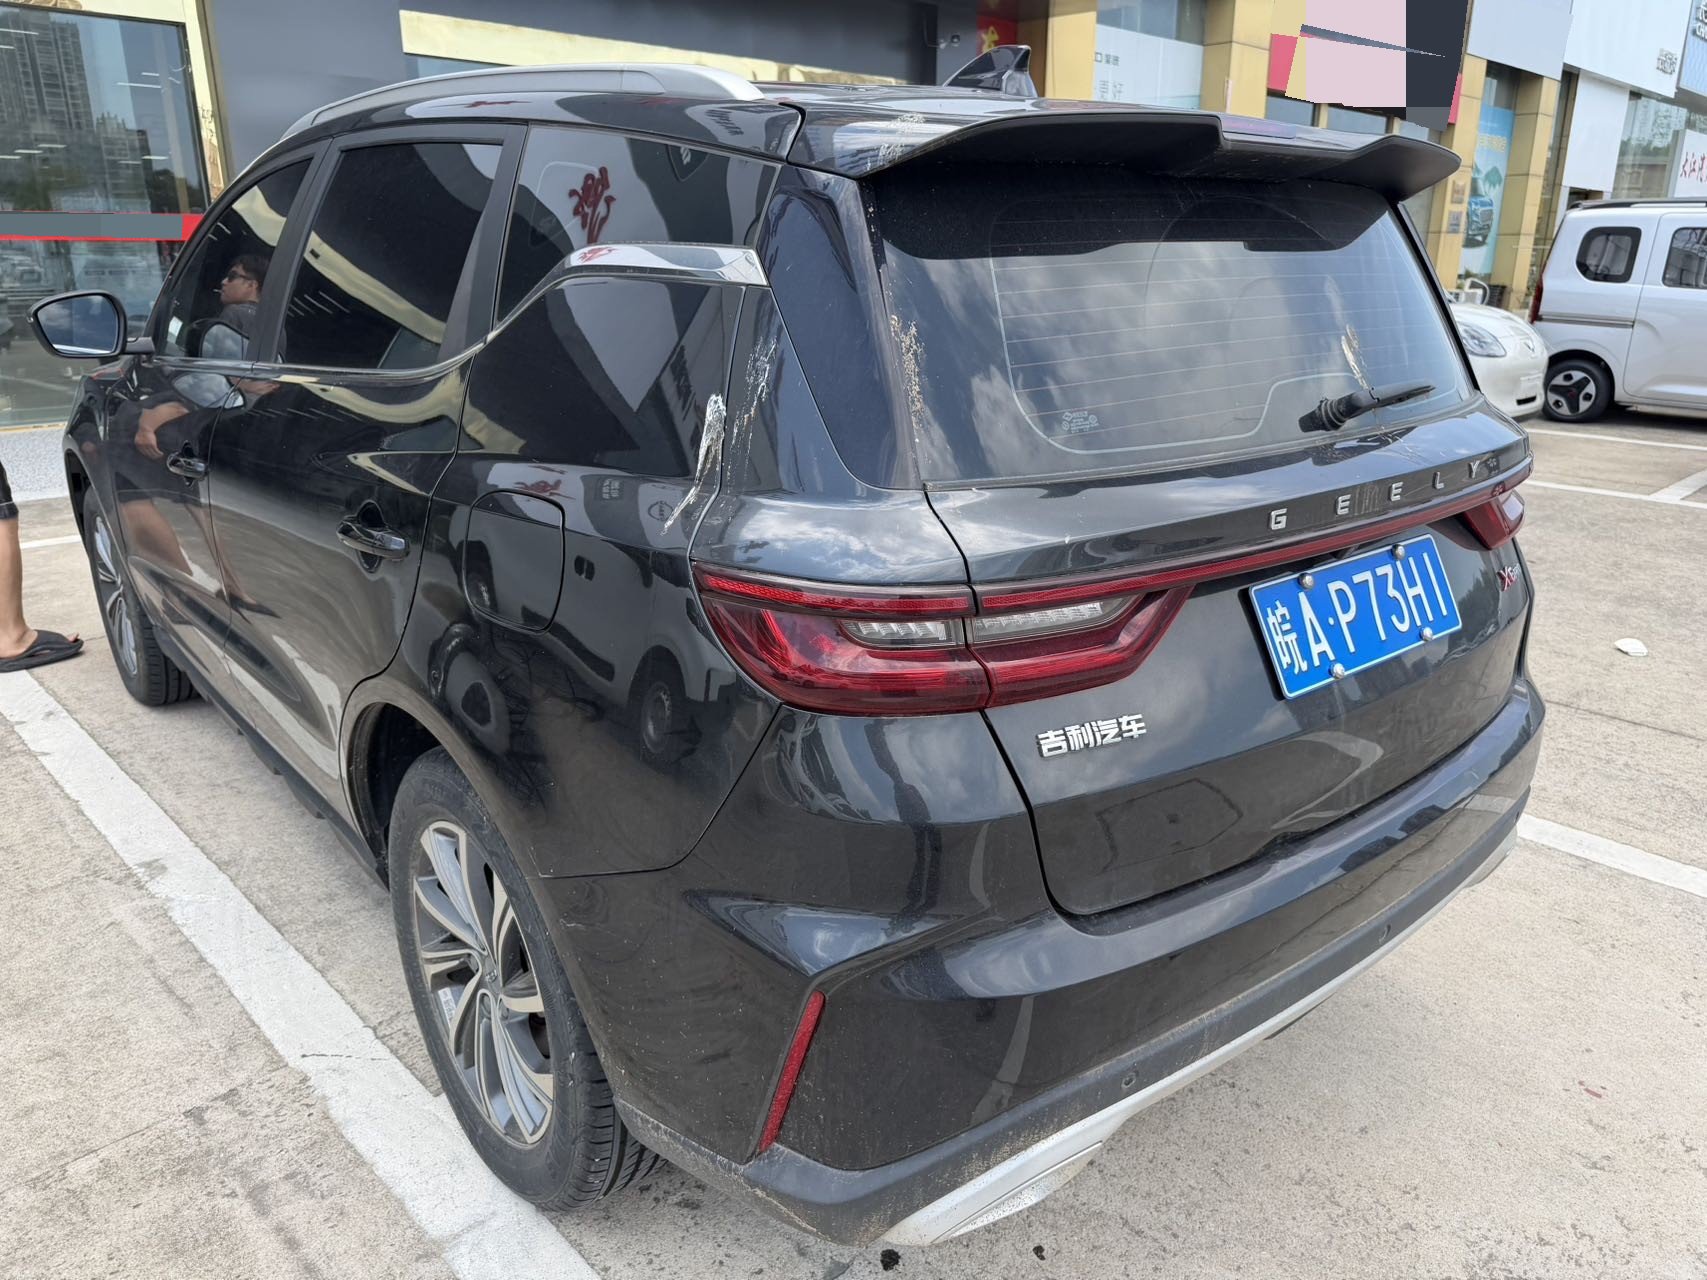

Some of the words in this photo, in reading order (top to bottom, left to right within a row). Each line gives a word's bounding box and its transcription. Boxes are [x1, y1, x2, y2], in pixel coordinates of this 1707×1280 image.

[1268, 460, 1481, 531] GEELY
[1037, 713, 1148, 758] 吉利汽车
